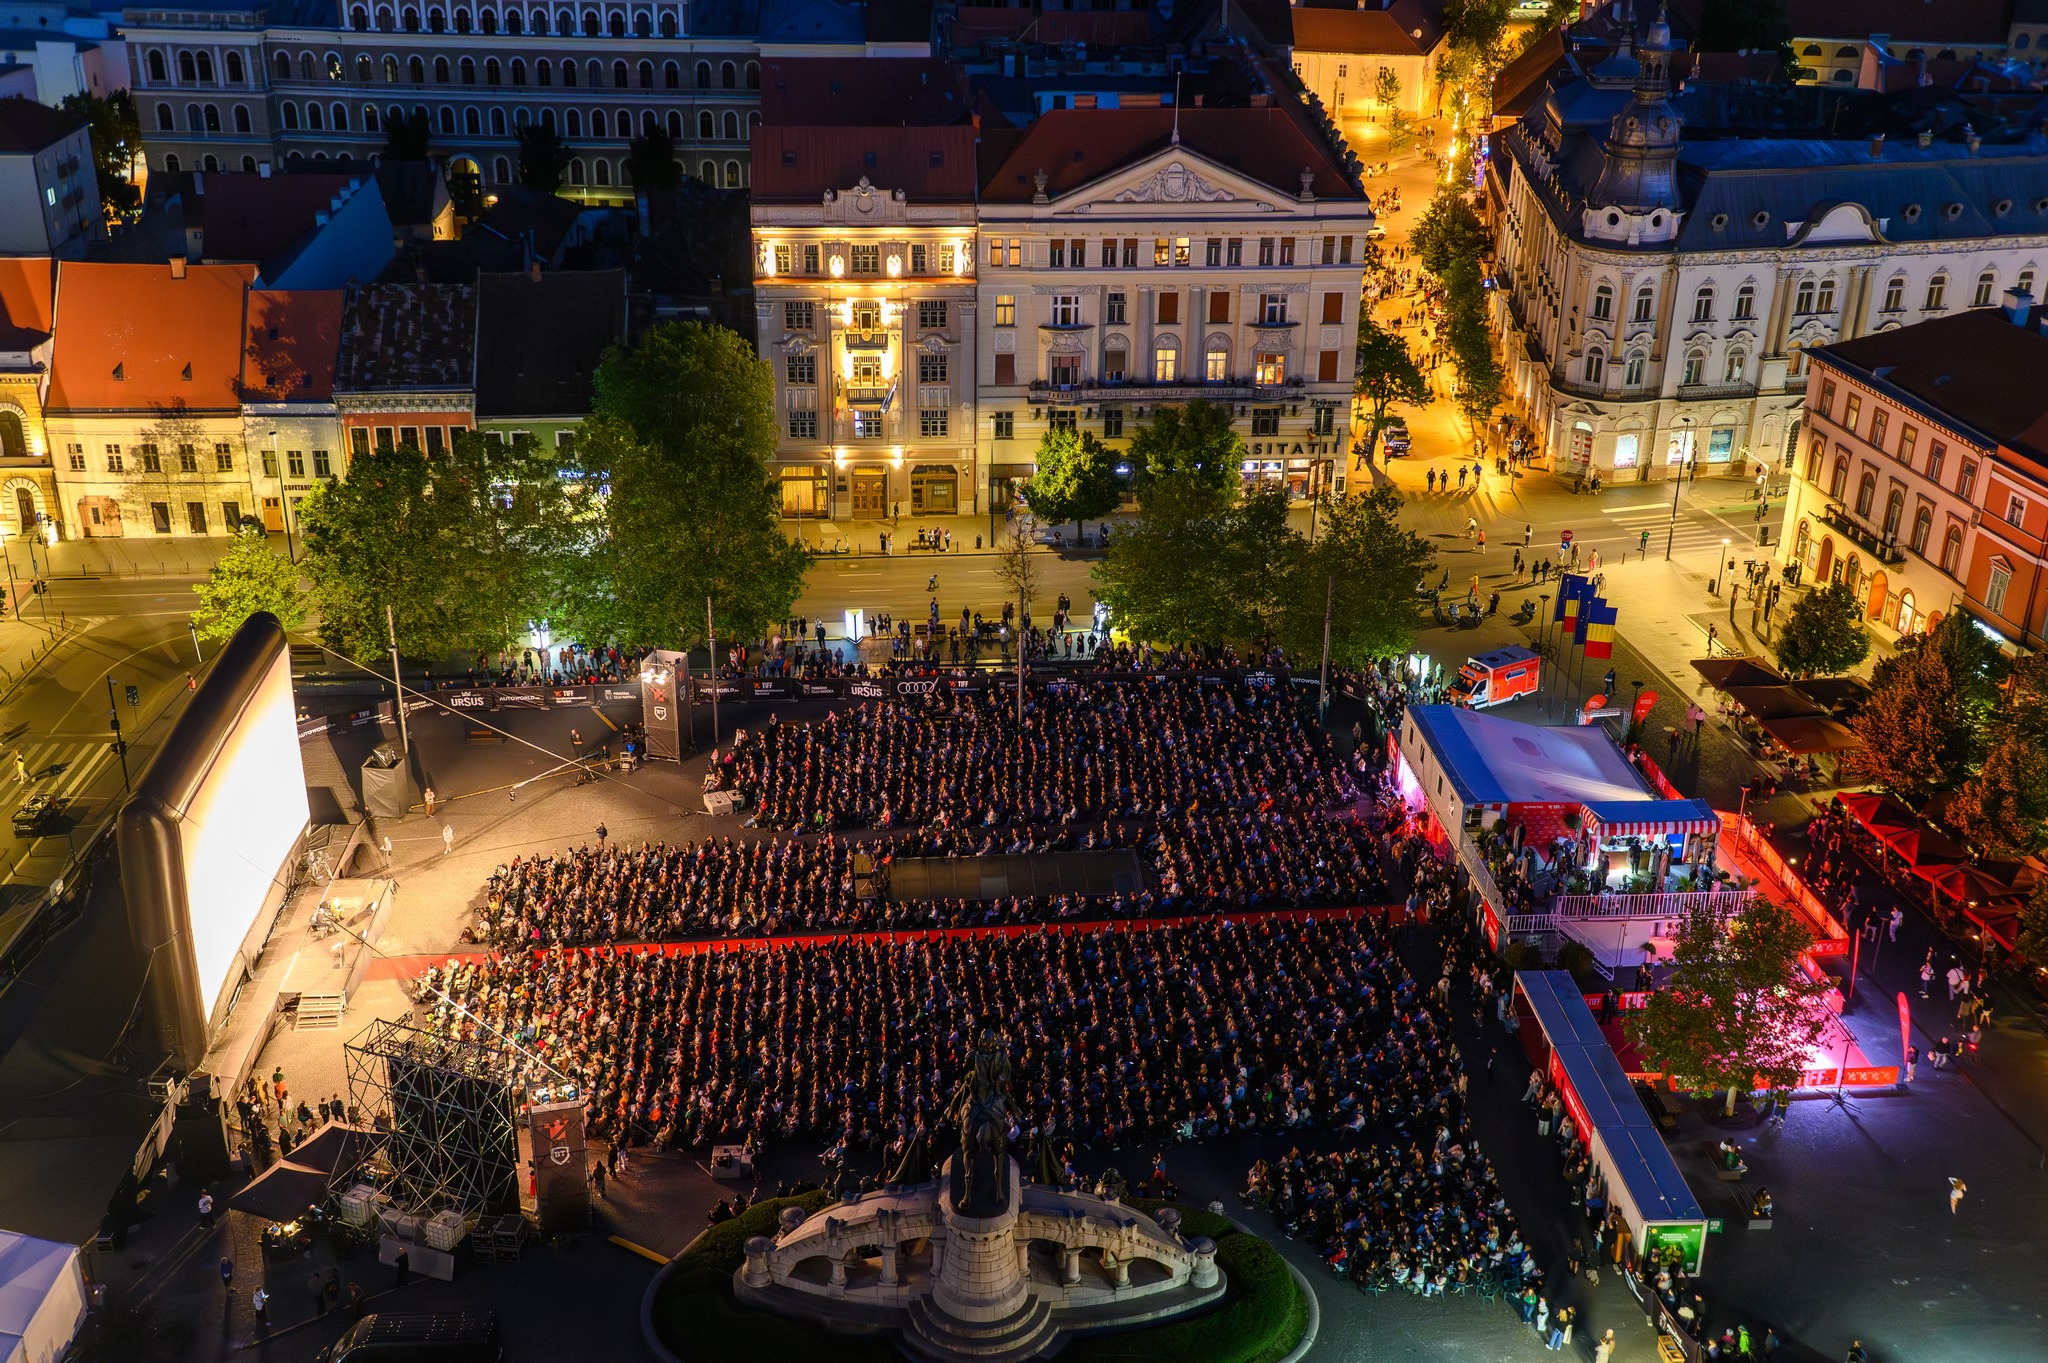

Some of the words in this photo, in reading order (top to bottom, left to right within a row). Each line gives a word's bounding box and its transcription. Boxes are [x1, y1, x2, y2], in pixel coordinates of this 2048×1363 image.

[1310, 398, 1342, 407] Tribuna
[958, 680, 969, 688] TIFF
[851, 686, 883, 697] URSUS
[451, 697, 485, 707] URSUS
[1588, 998, 1601, 1006] TIFF
